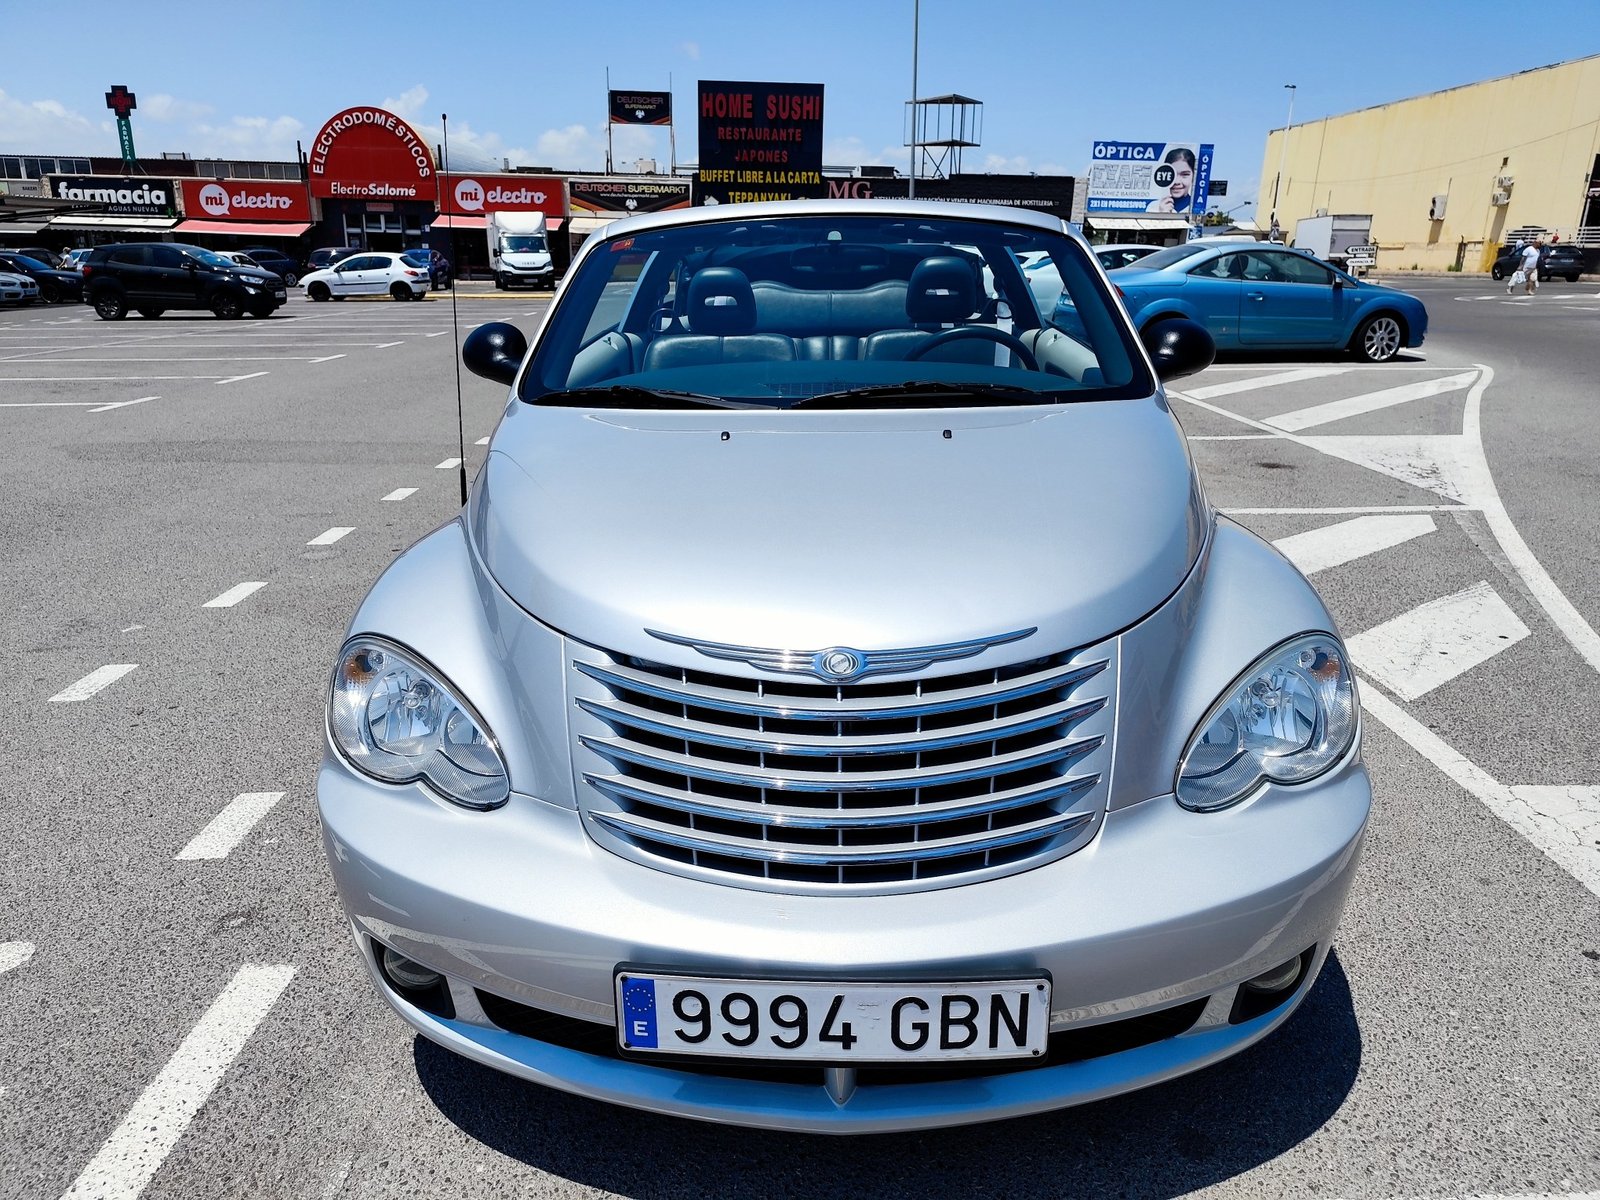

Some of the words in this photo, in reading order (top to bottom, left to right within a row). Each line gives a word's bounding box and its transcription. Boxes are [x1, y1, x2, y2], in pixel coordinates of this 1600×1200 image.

[616, 96, 664, 105] DEUTSCHER
[702, 93, 753, 118] HOME
[766, 94, 820, 120] SUSHI
[121, 120, 132, 160] FARMACIA
[718, 127, 803, 141] RESTAURANTE
[312, 111, 430, 178] ELECTRODOMÉSTICOS
[1094, 143, 1156, 160] ÓPTICA
[735, 150, 788, 163] JAPONES
[700, 170, 735, 182] BUFFET
[737, 170, 764, 183] LIBRE
[765, 171, 773, 183] A
[774, 171, 786, 184] LA
[787, 172, 821, 184] CARTA
[1156, 171, 1172, 182] EYE
[58, 181, 167, 205] farmacia
[460, 188, 480, 202] mi
[486, 185, 548, 205] electro
[574, 183, 627, 193] DEUTSCHER
[628, 184, 687, 194] SUPERMARKT
[826, 180, 873, 200] MG
[205, 193, 226, 206] mi
[231, 190, 293, 209] electro
[1109, 200, 1147, 209] PROGRESIVOS
[132, 205, 159, 213] NUEVAS
[633, 1020, 649, 1037] E
[672, 989, 858, 1050] 9994
[890, 992, 1030, 1051] GBN
